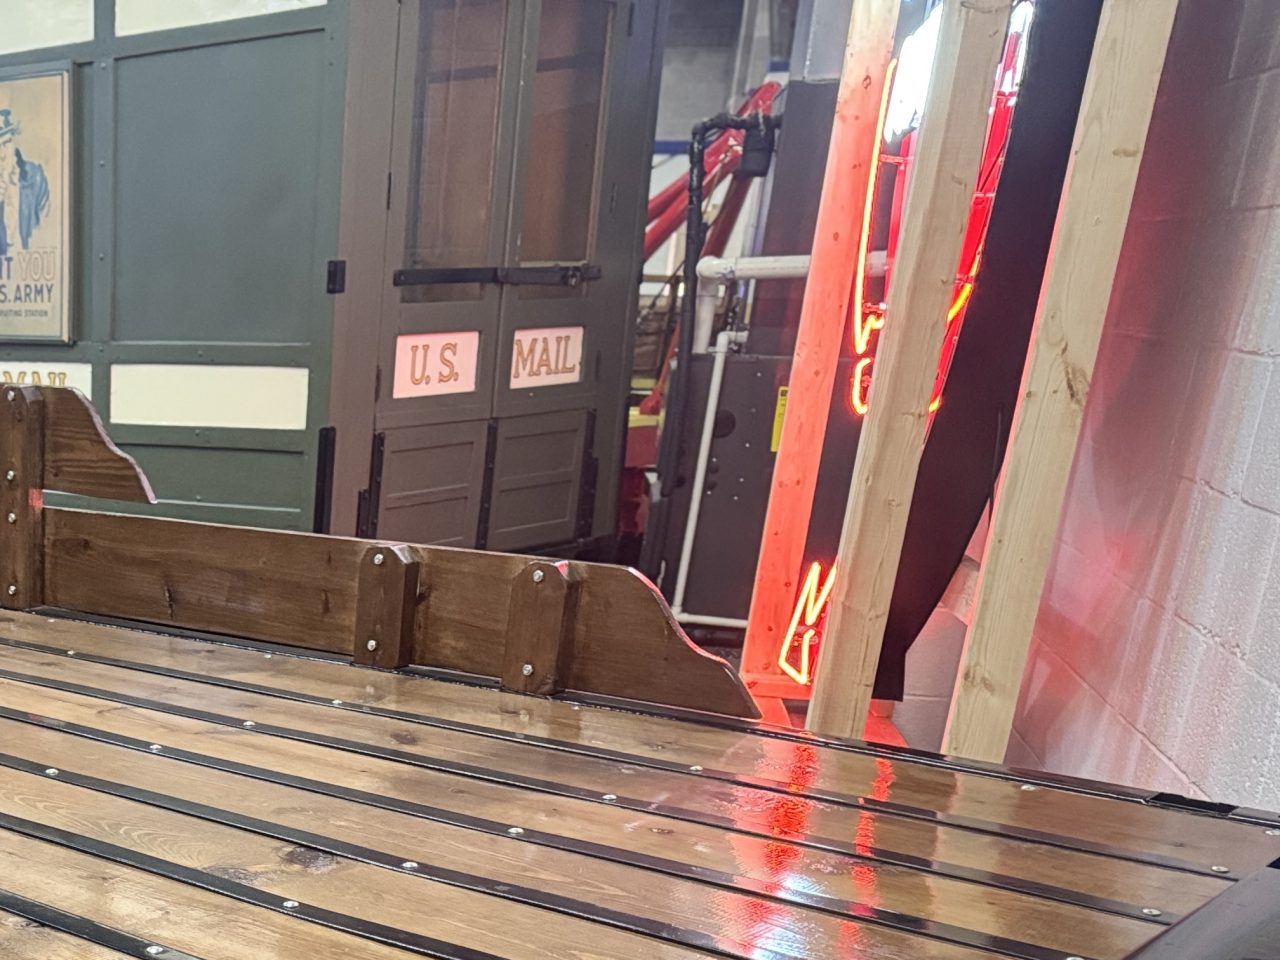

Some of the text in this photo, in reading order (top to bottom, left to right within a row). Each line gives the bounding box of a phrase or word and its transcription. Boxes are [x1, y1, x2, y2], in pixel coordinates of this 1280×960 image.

[16, 250, 57, 282] YOU
[13, 283, 54, 303] ARMY
[513, 335, 576, 379] MAIL
